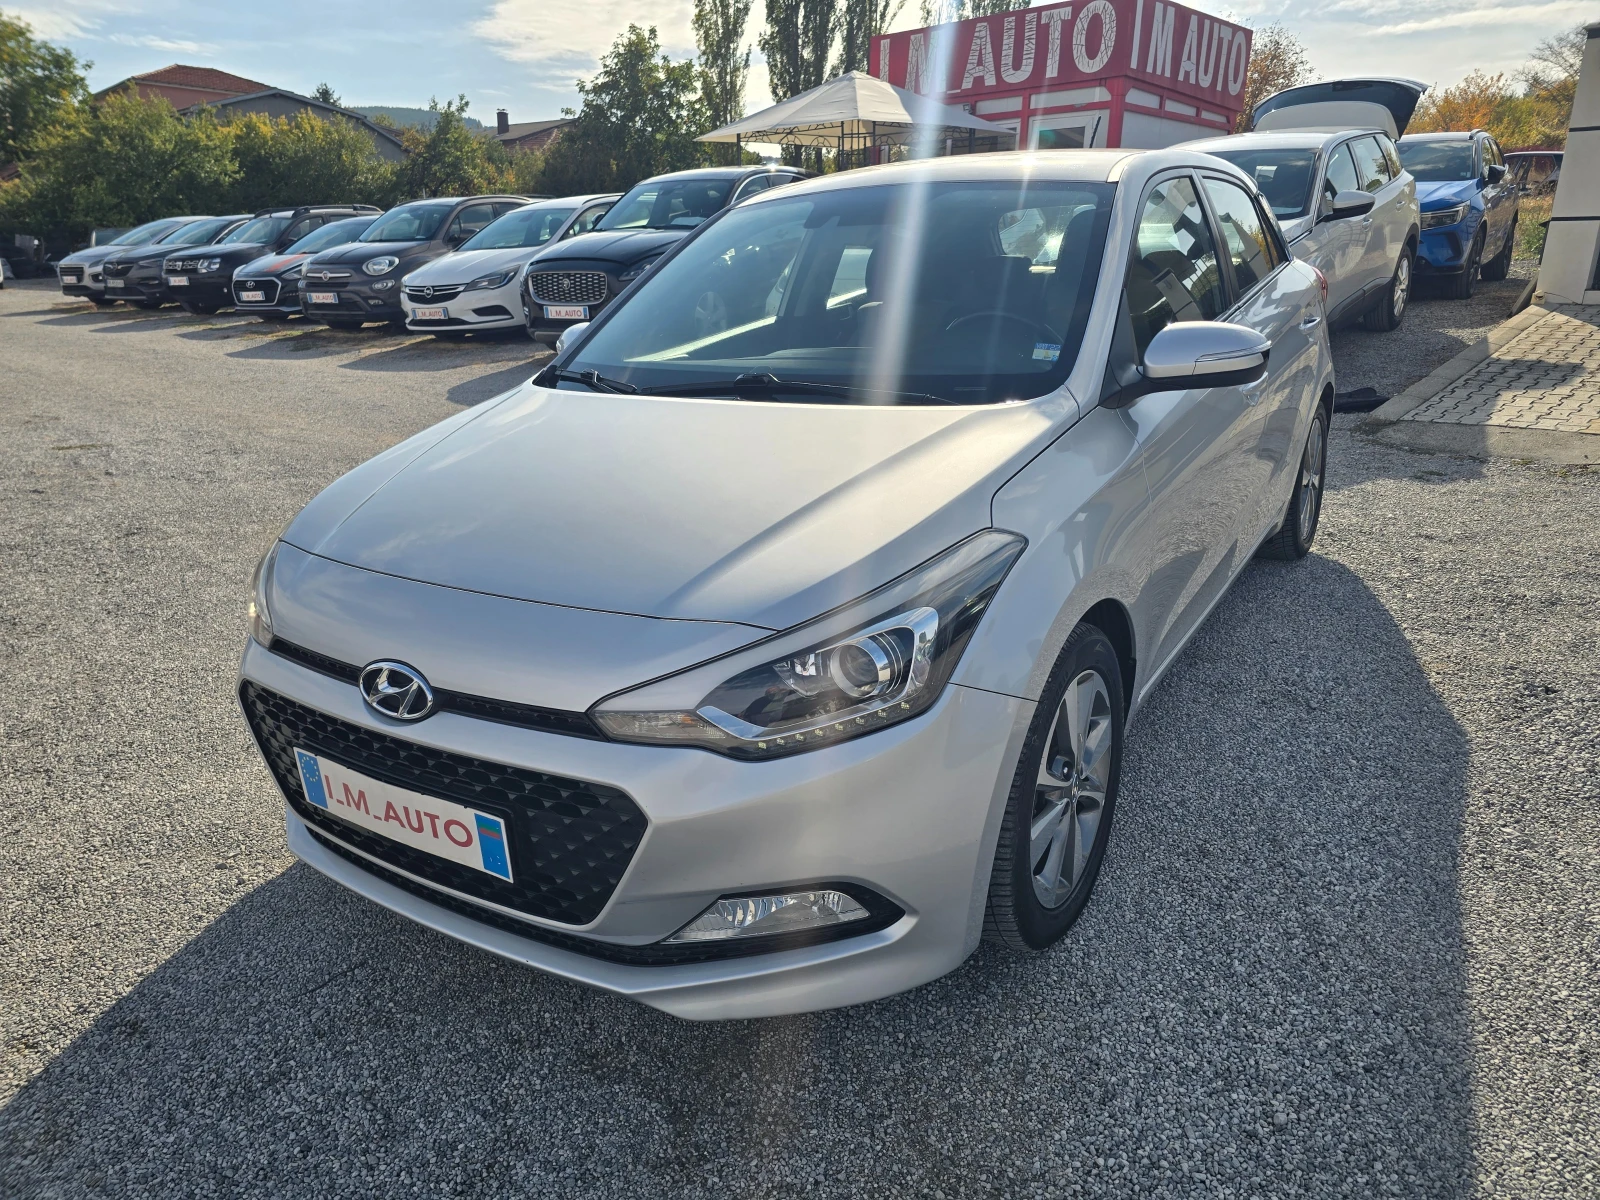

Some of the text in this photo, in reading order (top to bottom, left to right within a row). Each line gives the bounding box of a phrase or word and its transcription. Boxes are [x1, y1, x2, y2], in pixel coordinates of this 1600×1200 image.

[1130, 0, 1247, 96] I M AUTO
[550, 310, 583, 318] I_M_AUTO
[324, 774, 474, 848] I_M_AUTO
